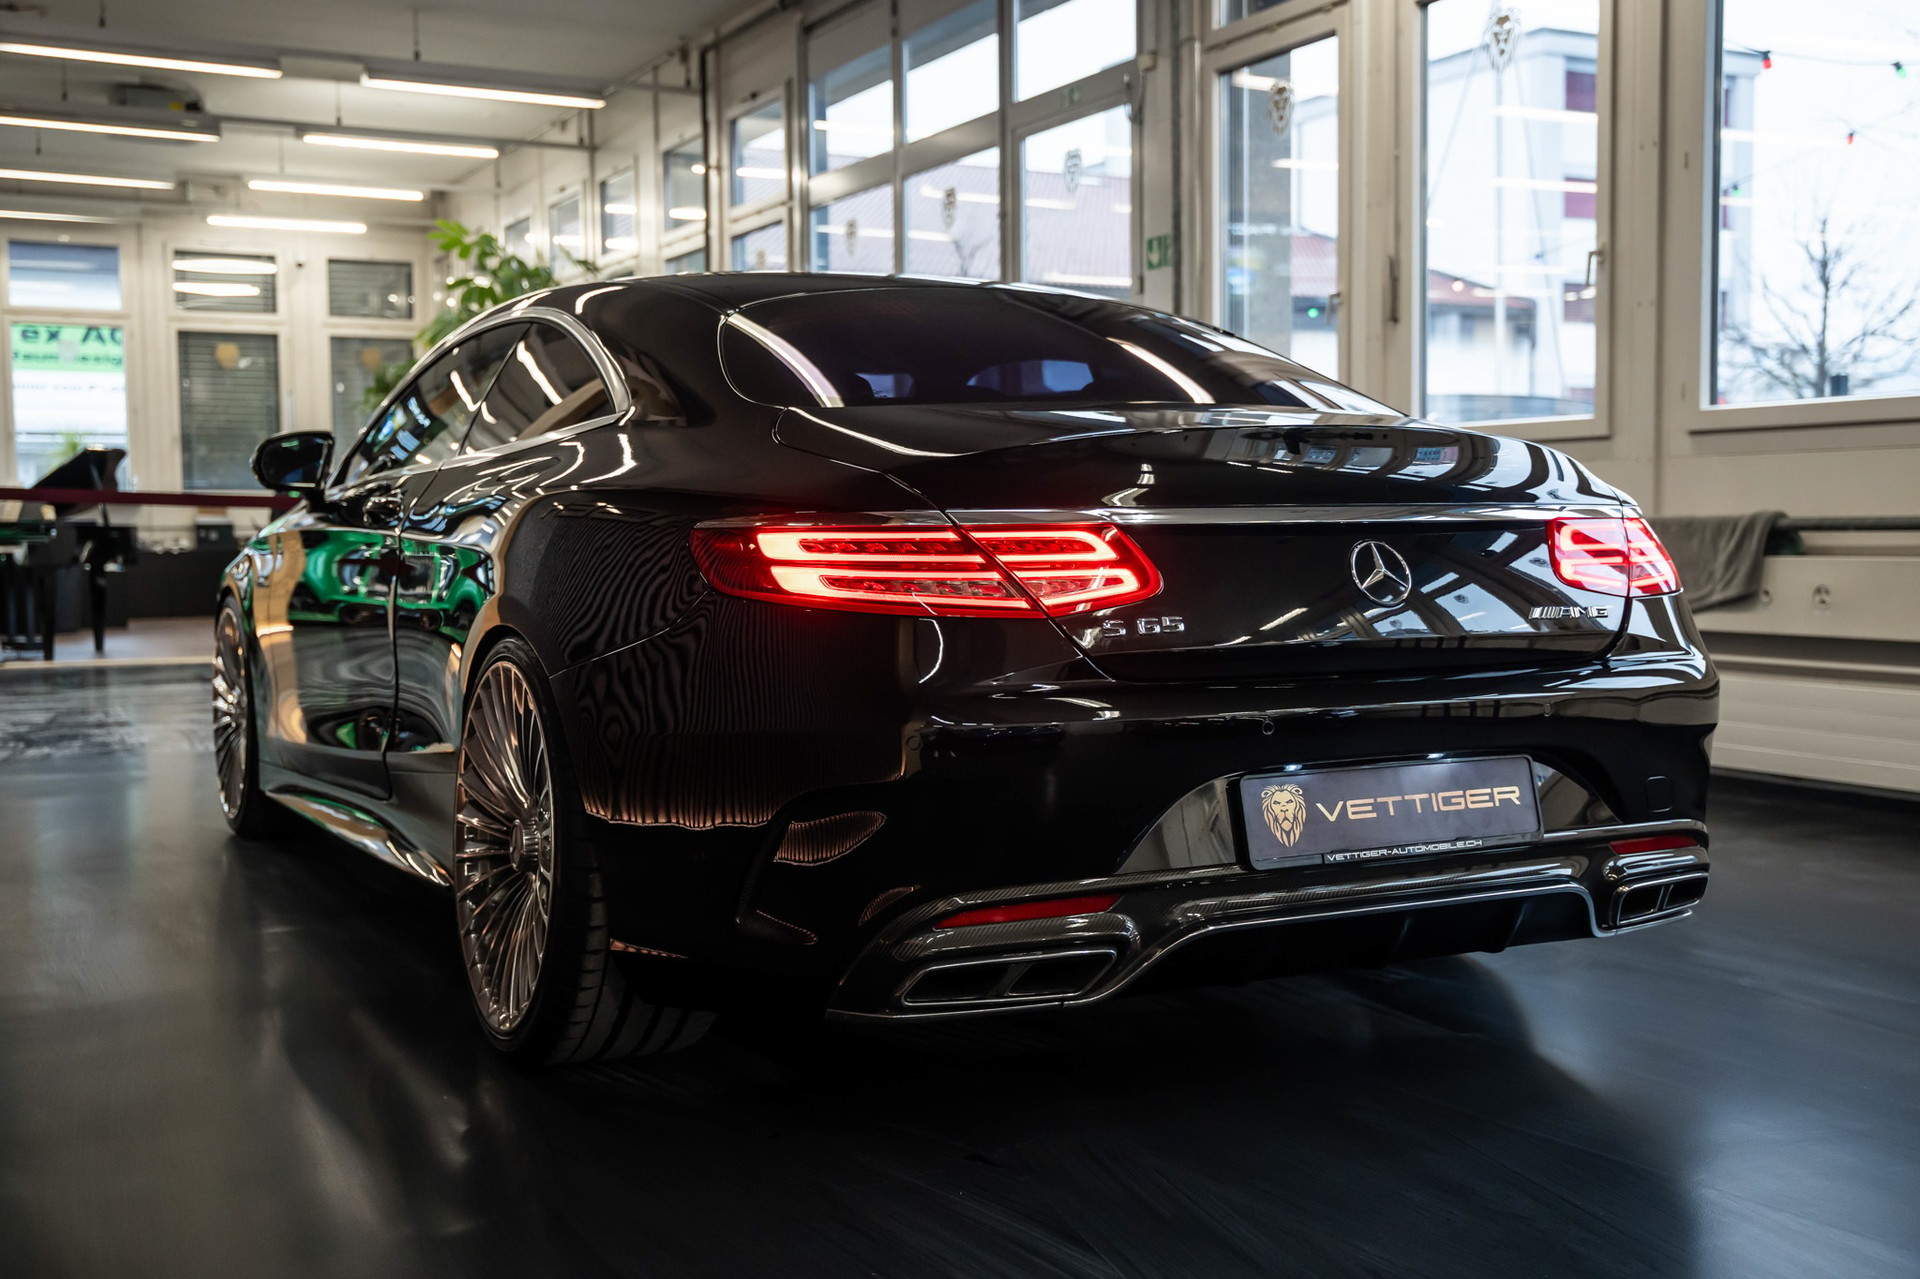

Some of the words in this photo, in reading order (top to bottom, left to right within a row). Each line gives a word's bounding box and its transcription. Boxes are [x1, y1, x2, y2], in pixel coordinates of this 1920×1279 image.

[1557, 606, 1609, 619] AMG
[1102, 620, 1126, 637] S
[1137, 616, 1185, 635] 65
[1315, 785, 1521, 822] VETTIGER
